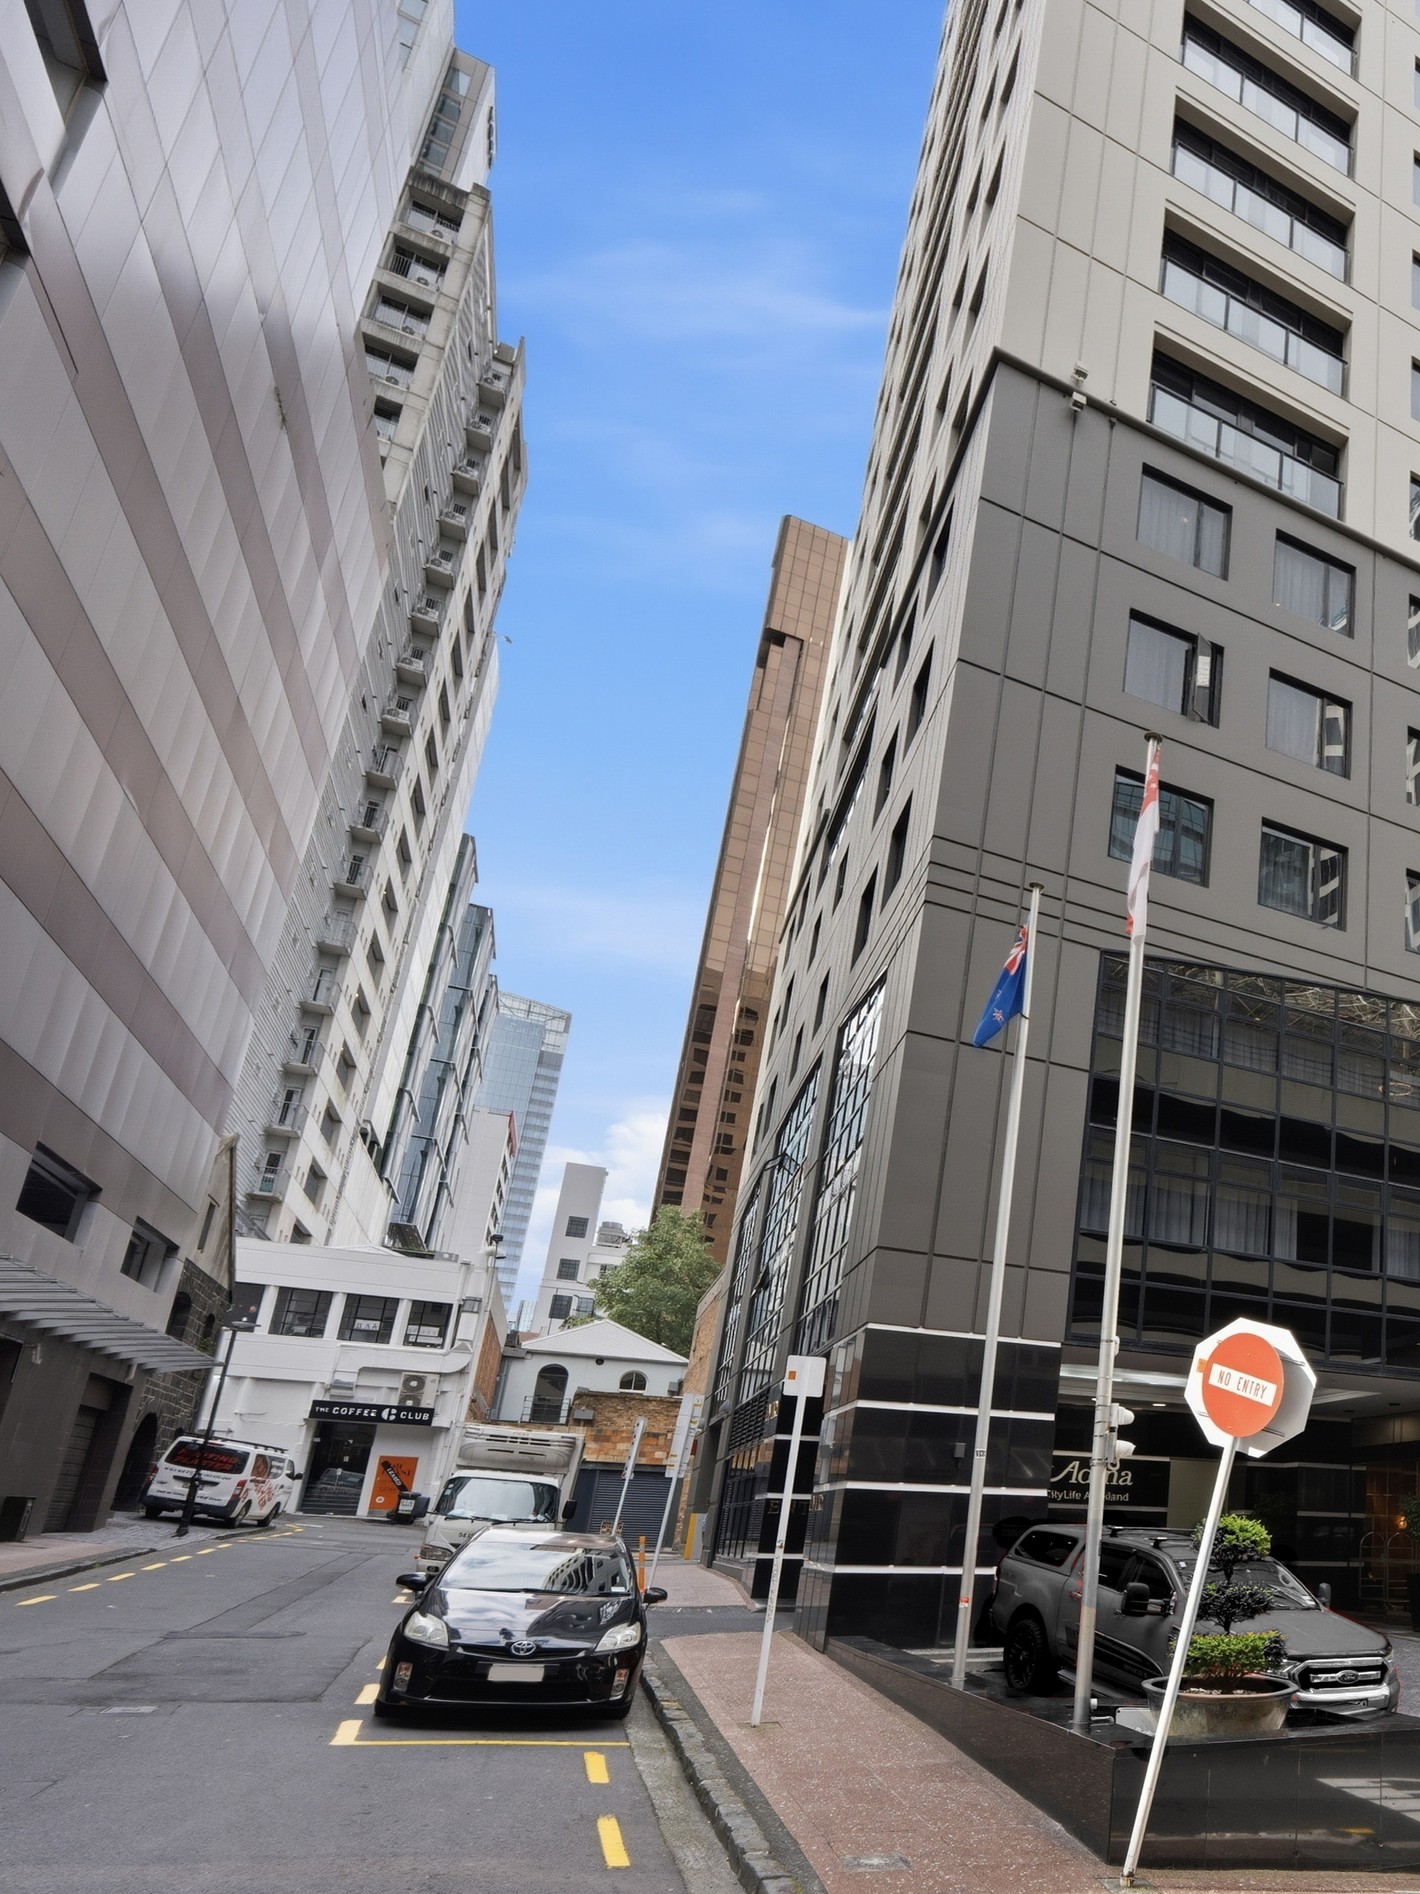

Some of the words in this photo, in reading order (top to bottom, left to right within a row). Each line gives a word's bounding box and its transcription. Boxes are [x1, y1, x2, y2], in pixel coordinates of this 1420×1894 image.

[1217, 1369, 1232, 1387] NO
[1236, 1376, 1268, 1399] ENTRY
[332, 1407, 378, 1417] COFFEE
[400, 1411, 430, 1420] CLUB
[1050, 1460, 1133, 1486] Adna
